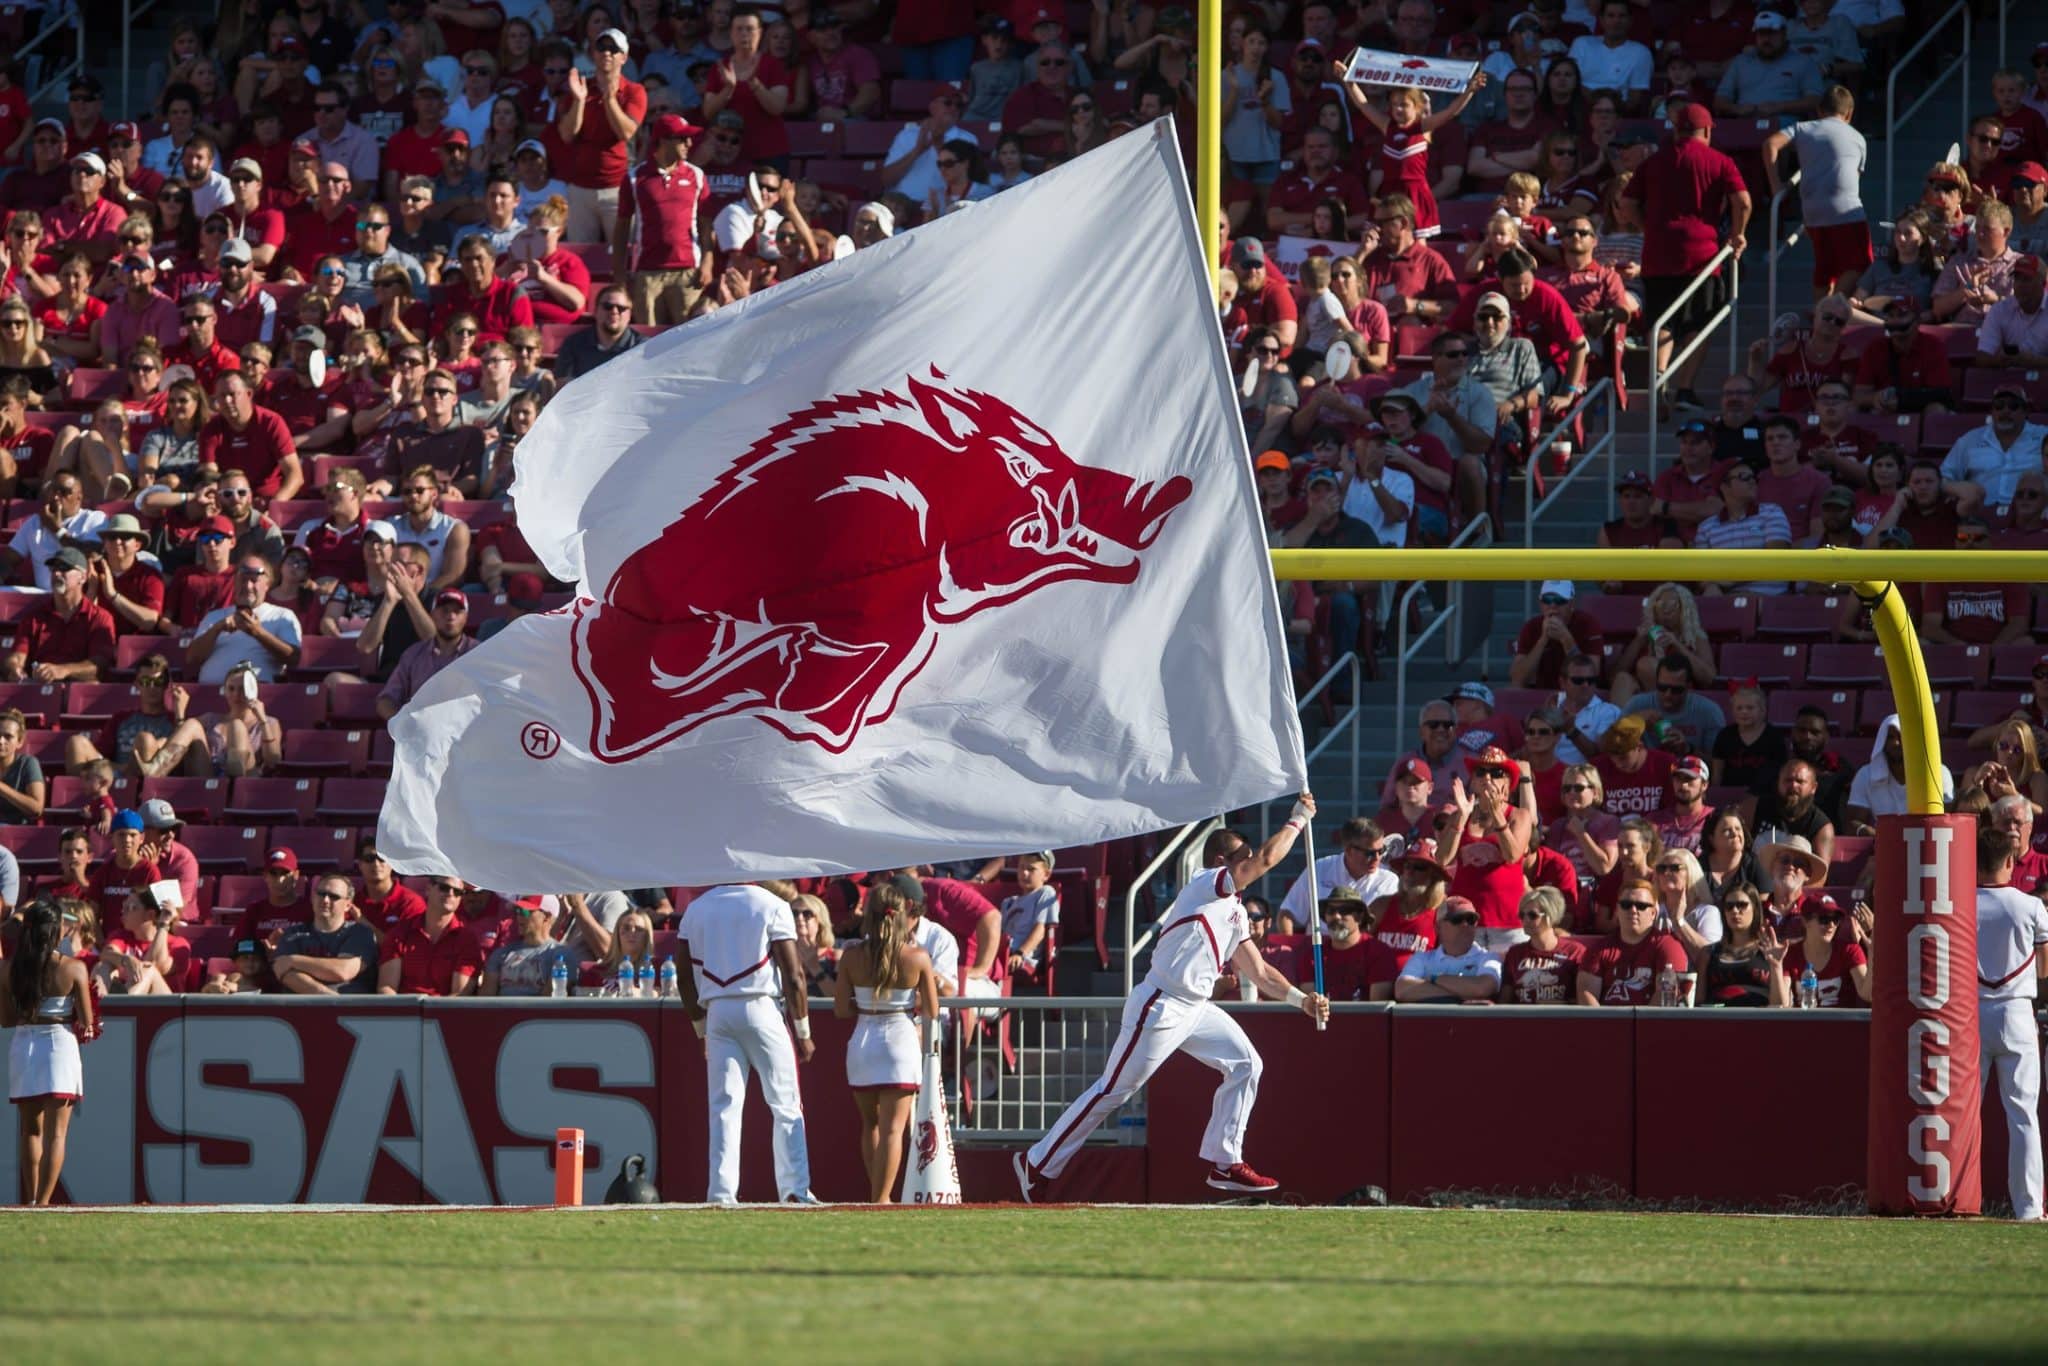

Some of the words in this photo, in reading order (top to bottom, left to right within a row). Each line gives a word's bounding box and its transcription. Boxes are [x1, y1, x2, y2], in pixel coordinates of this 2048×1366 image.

[1354, 68, 1390, 81] WOOO
[1393, 72, 1415, 84] PIG
[1606, 788, 1641, 799] WOOO
[1606, 798, 1660, 813] SOOIE
[1903, 827, 1953, 1202] HOGS
